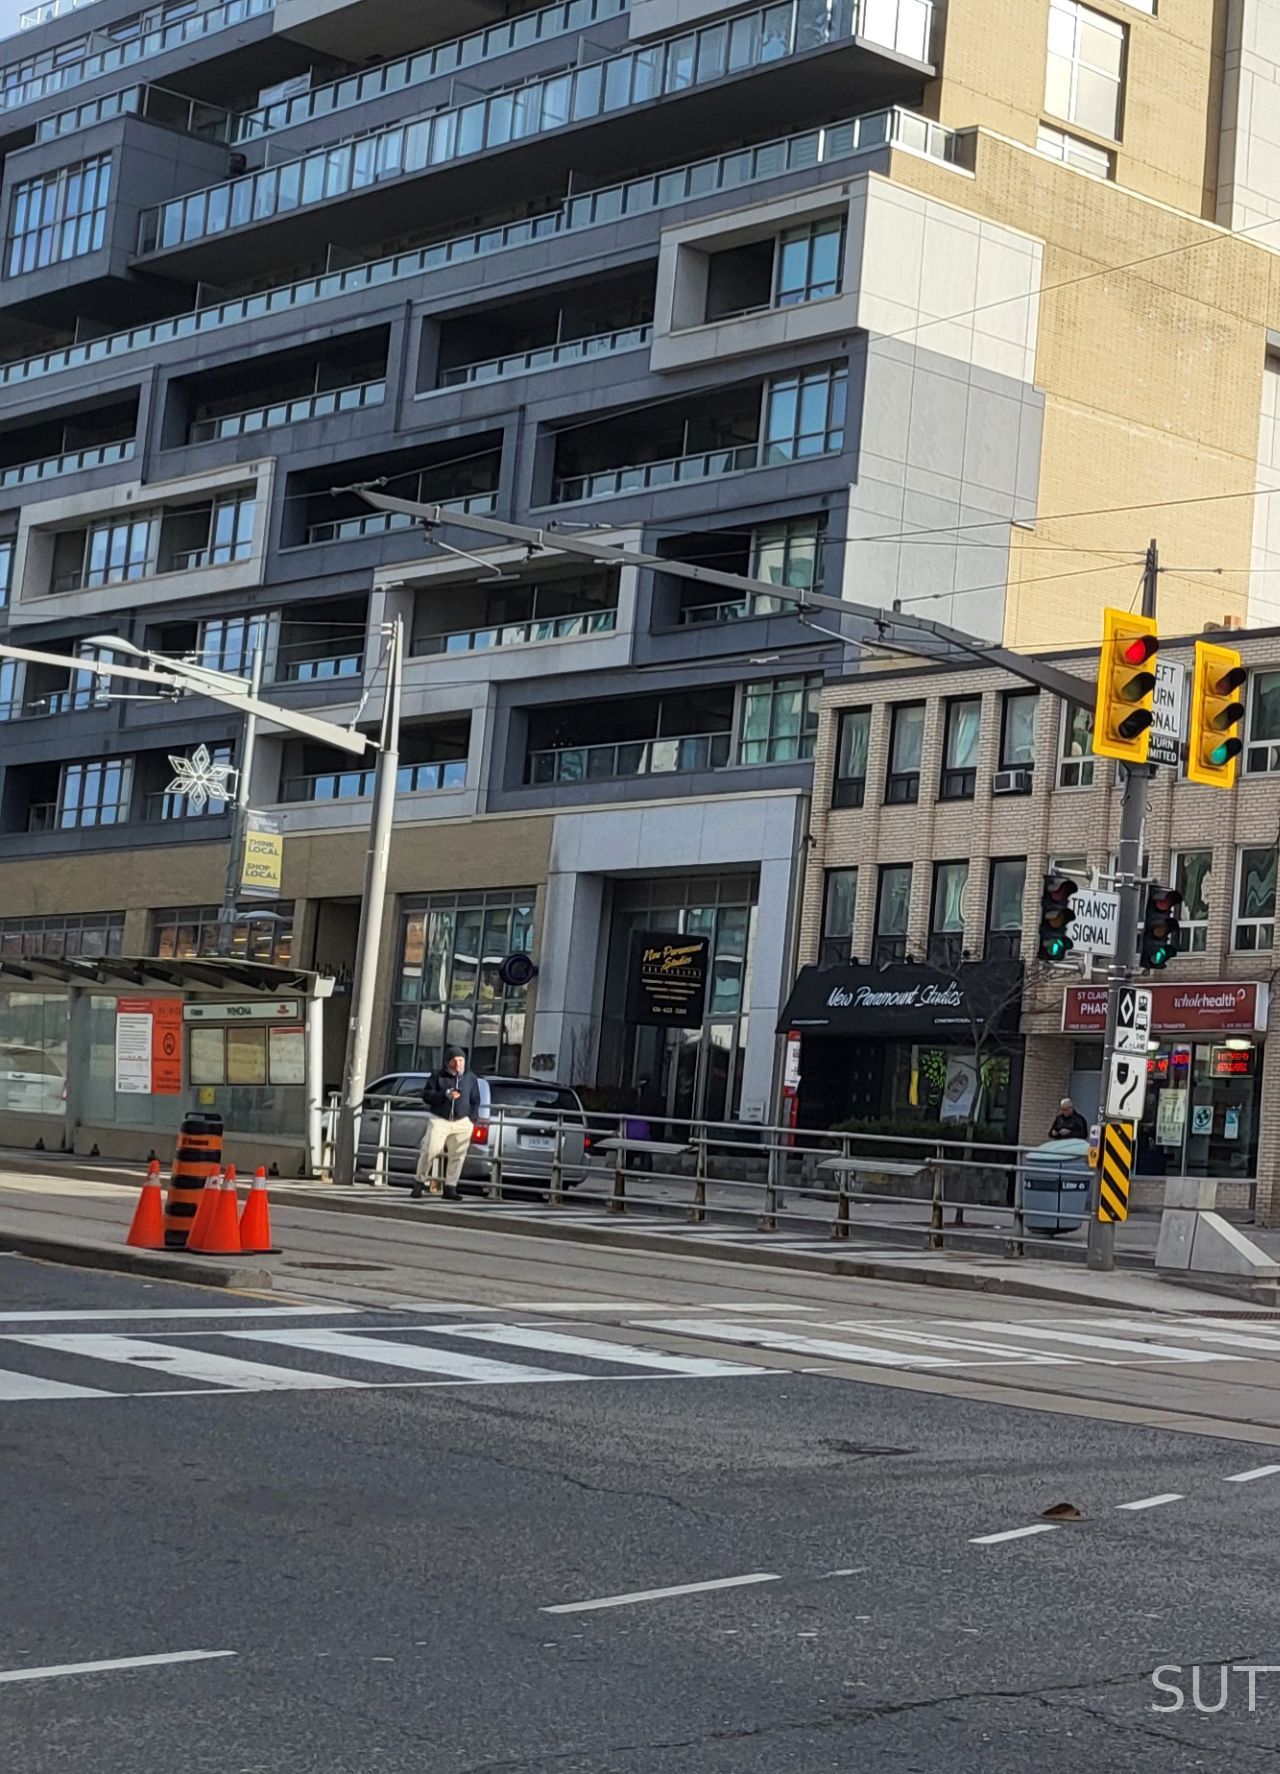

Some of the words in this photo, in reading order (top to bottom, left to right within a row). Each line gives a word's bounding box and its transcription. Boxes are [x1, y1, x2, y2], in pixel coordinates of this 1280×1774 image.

[1155, 664, 1177, 684] EFT
[1152, 687, 1175, 708] URN
[249, 838, 275, 848] THINK
[248, 846, 280, 857] LOCAL
[247, 862, 271, 871] SHOP
[245, 870, 279, 881] LOCAL
[1071, 897, 1118, 921] TRANSIT
[1071, 923, 1112, 946] SIGNAL
[826, 986, 854, 1008] New
[852, 984, 921, 1008] Paramount
[914, 980, 965, 1008] Studios
[1077, 991, 1087, 1001] ST
[1087, 991, 1108, 1000] CLAIR
[1174, 992, 1236, 1008] wholehealth
[226, 1006, 253, 1016] WINONA
[1080, 1002, 1109, 1015] PHAR
